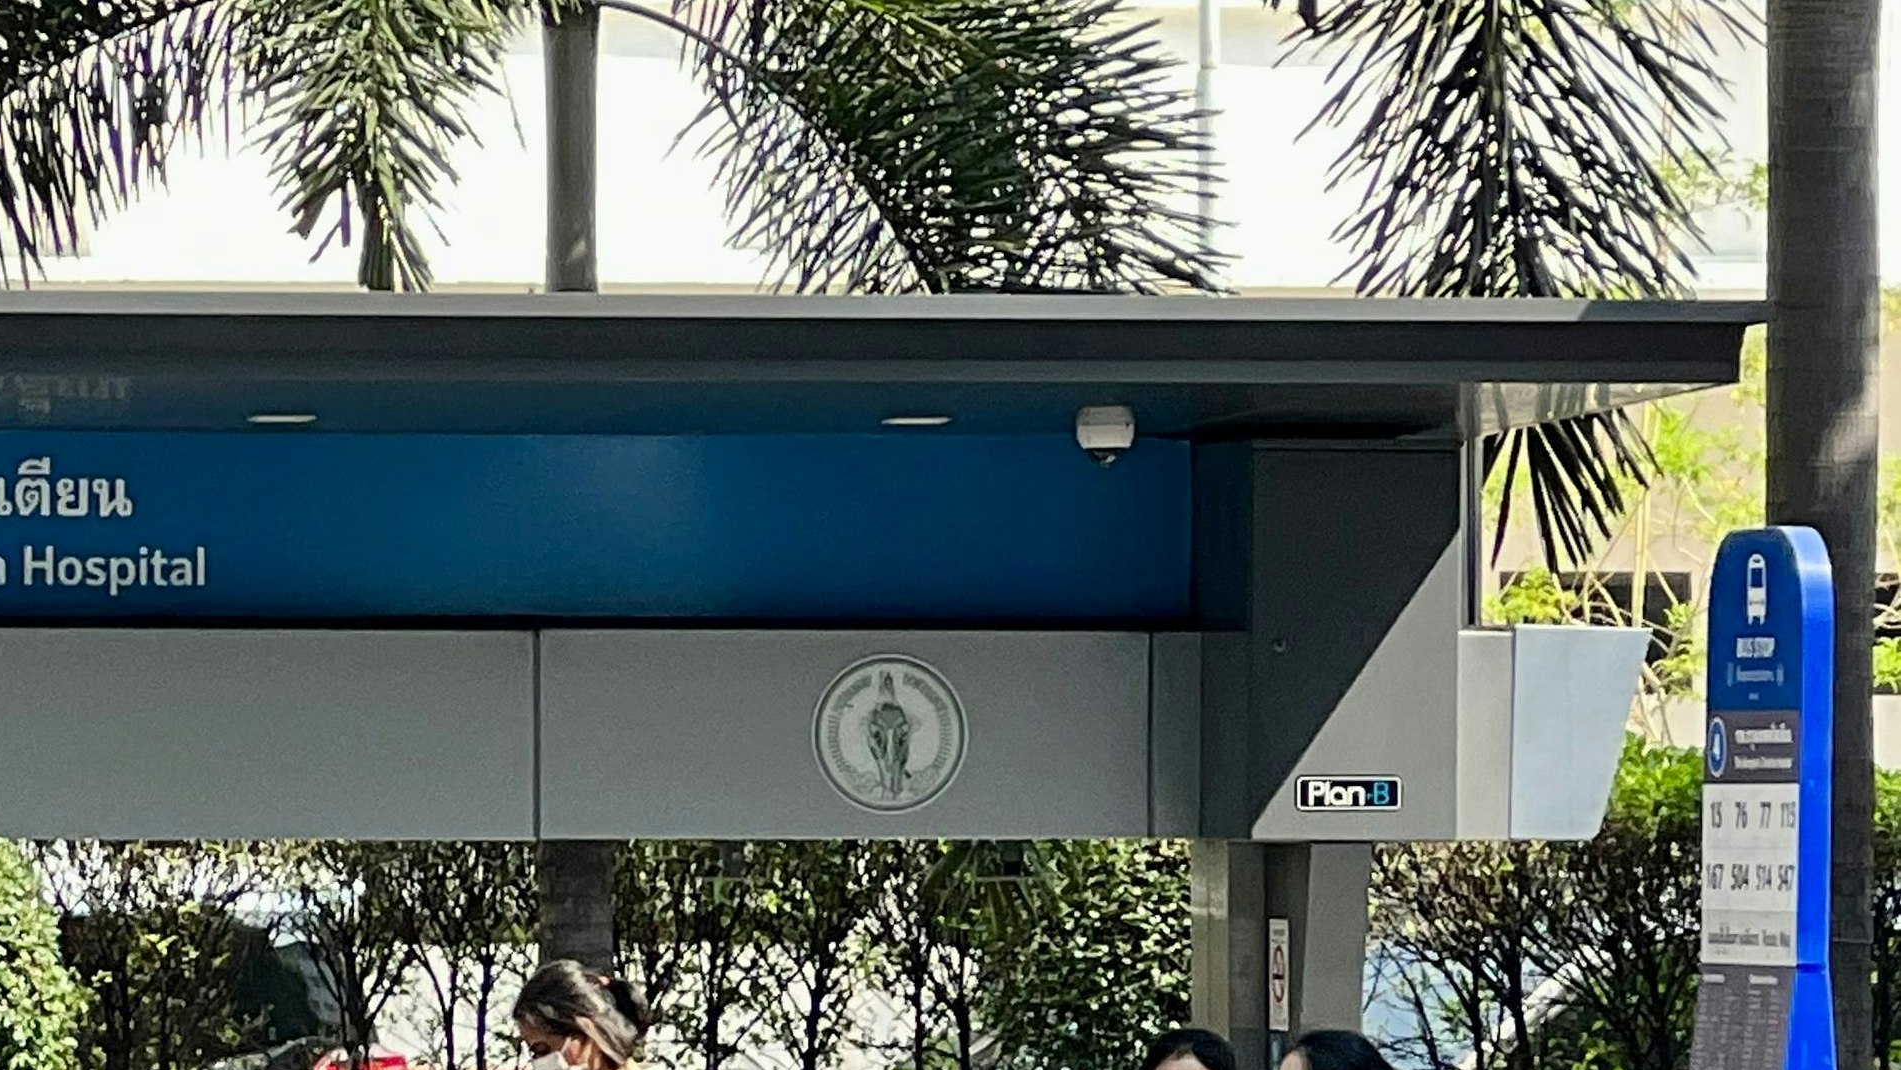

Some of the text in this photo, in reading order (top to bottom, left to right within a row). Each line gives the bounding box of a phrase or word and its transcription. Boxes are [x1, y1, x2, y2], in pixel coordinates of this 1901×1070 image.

[24, 545, 207, 597] Hospital
[1734, 801, 1749, 829] 76
[1759, 801, 1772, 829] 77
